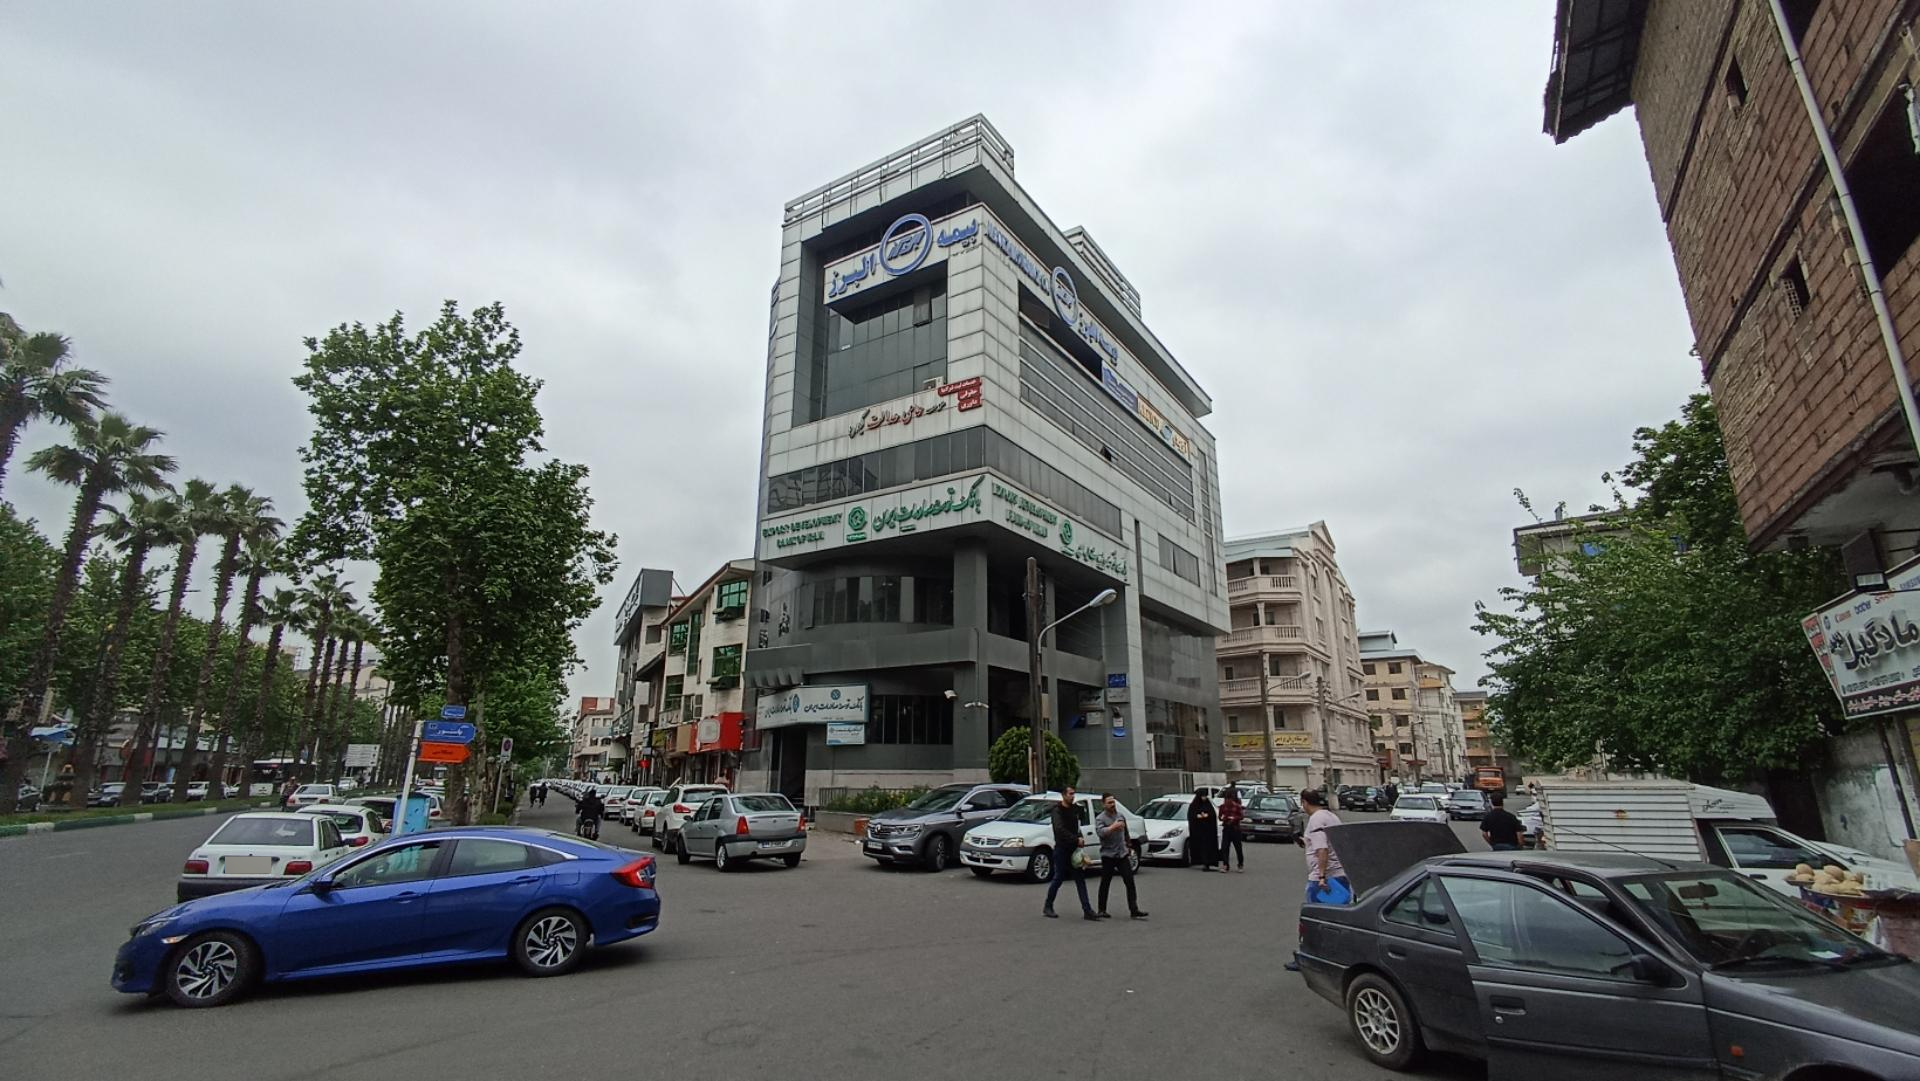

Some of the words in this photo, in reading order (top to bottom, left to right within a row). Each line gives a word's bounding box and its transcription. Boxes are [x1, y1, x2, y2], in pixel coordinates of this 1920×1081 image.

[937, 218, 979, 248] بیمه
[828, 253, 877, 297] البرز
[952, 475, 986, 514] بانک
[872, 505, 897, 532] ایران
[803, 703, 818, 713] ایران
[849, 695, 865, 711] بانک
